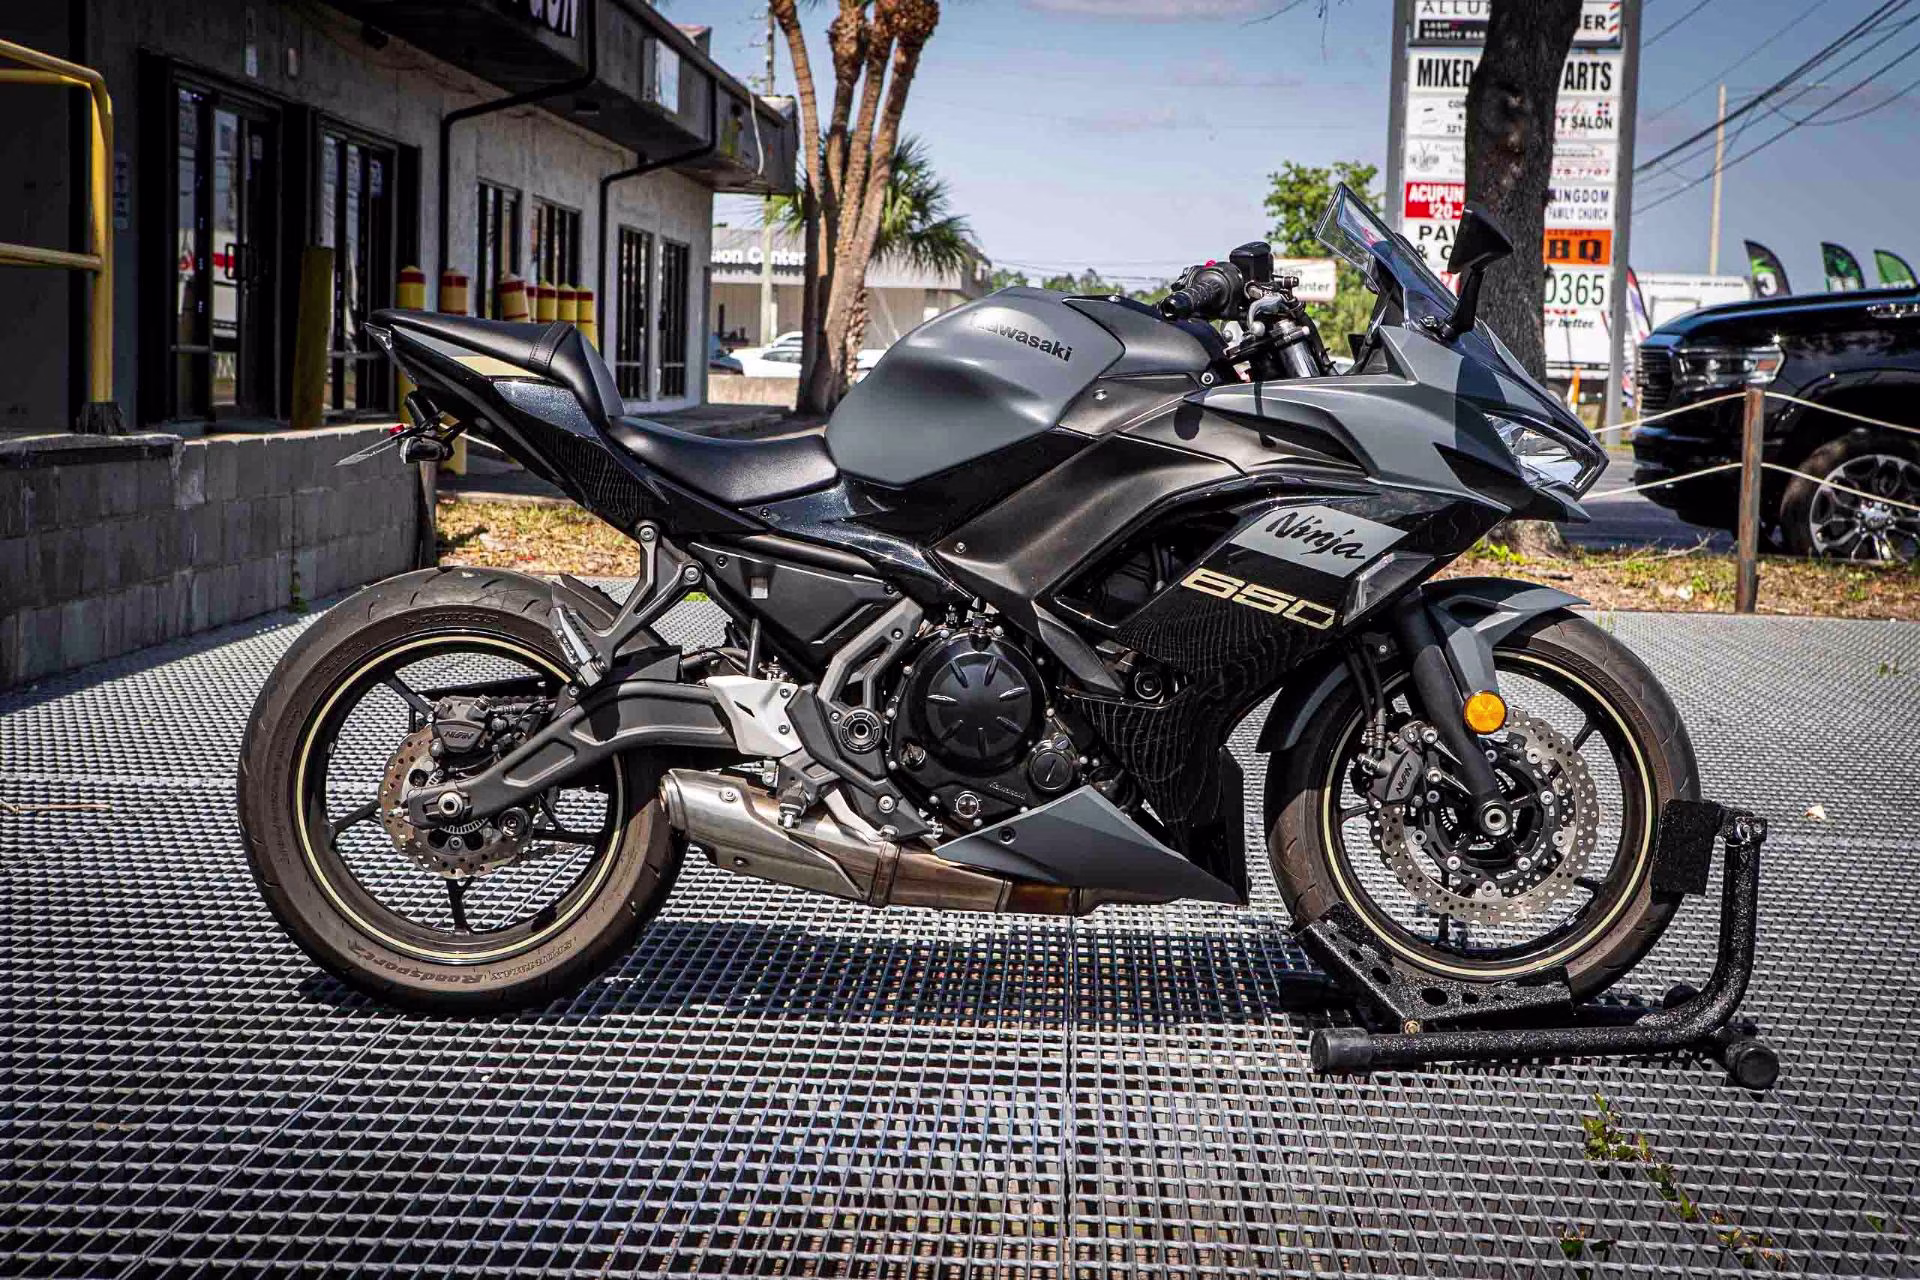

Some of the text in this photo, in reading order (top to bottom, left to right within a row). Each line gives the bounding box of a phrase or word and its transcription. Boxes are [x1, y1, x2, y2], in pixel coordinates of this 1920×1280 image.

[1417, 58, 1612, 91] MIXED ARTS
[1571, 115, 1613, 130] SALON
[1265, 511, 1366, 560] Ninja
[1180, 567, 1336, 631] 650
